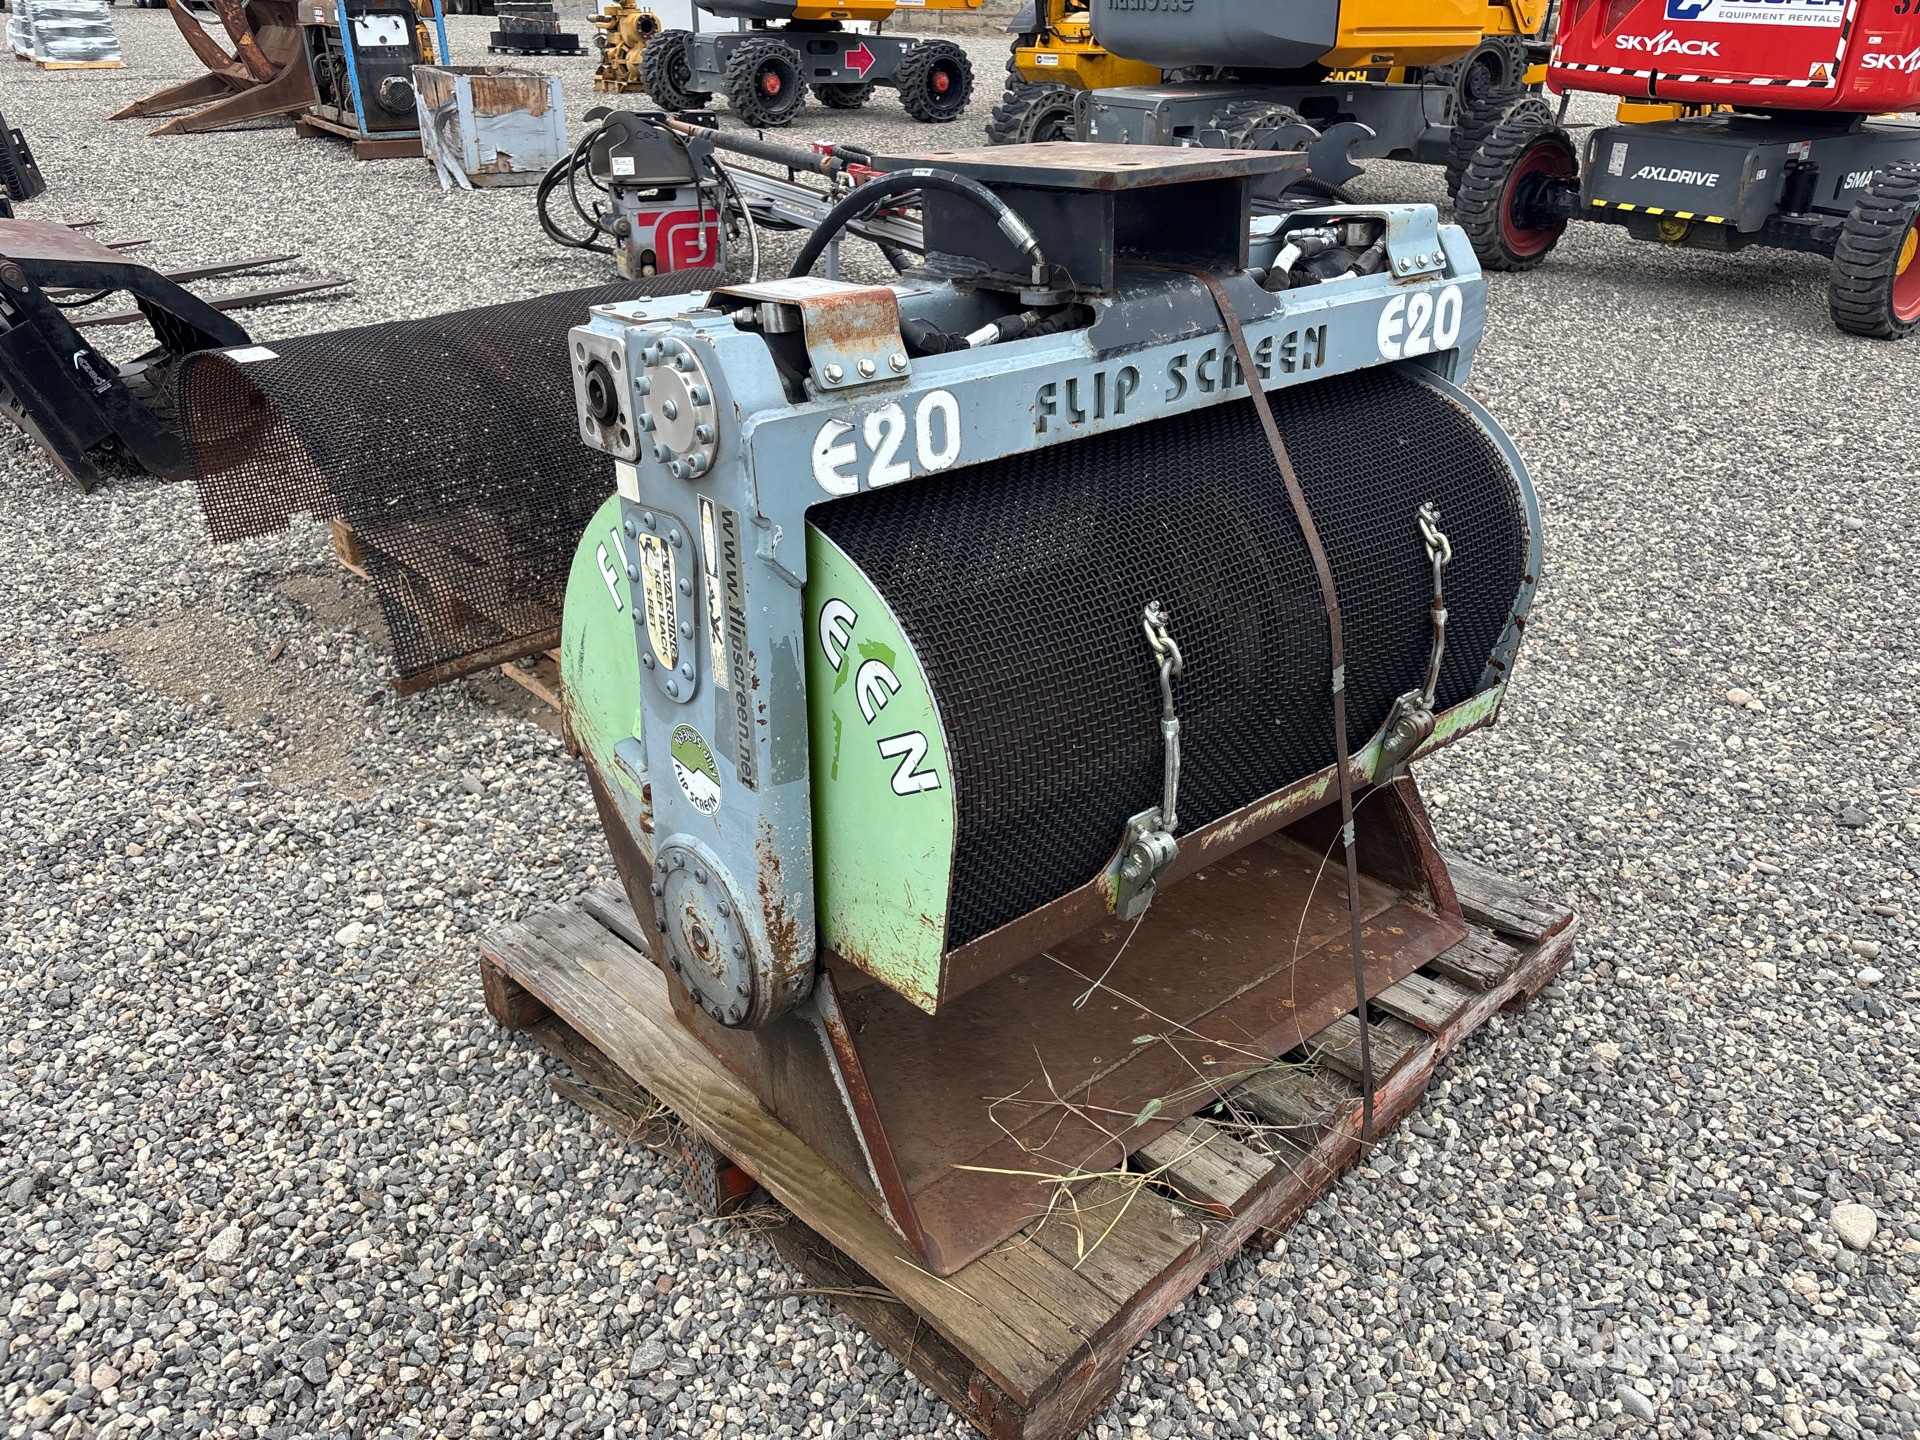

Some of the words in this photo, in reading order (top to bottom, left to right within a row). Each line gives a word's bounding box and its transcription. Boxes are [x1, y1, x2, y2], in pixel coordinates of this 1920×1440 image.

[1718, 11, 1785, 21] EQUIPMENT
[1788, 14, 1841, 23] RENTALS
[1614, 29, 1721, 57] SKYJACK
[1630, 165, 1720, 188] AXLDRIVE
[1844, 169, 1883, 190] SMA
[1376, 284, 1463, 360] E20
[1034, 364, 1140, 435] FLIP
[1165, 324, 1328, 403] SCREEN
[811, 389, 963, 497] E20
[654, 568, 664, 613] KEEP
[647, 597, 657, 631] FEET
[658, 613, 669, 657] BACK
[722, 509, 756, 790] www.flipscreen.net
[675, 763, 689, 790] FLIP
